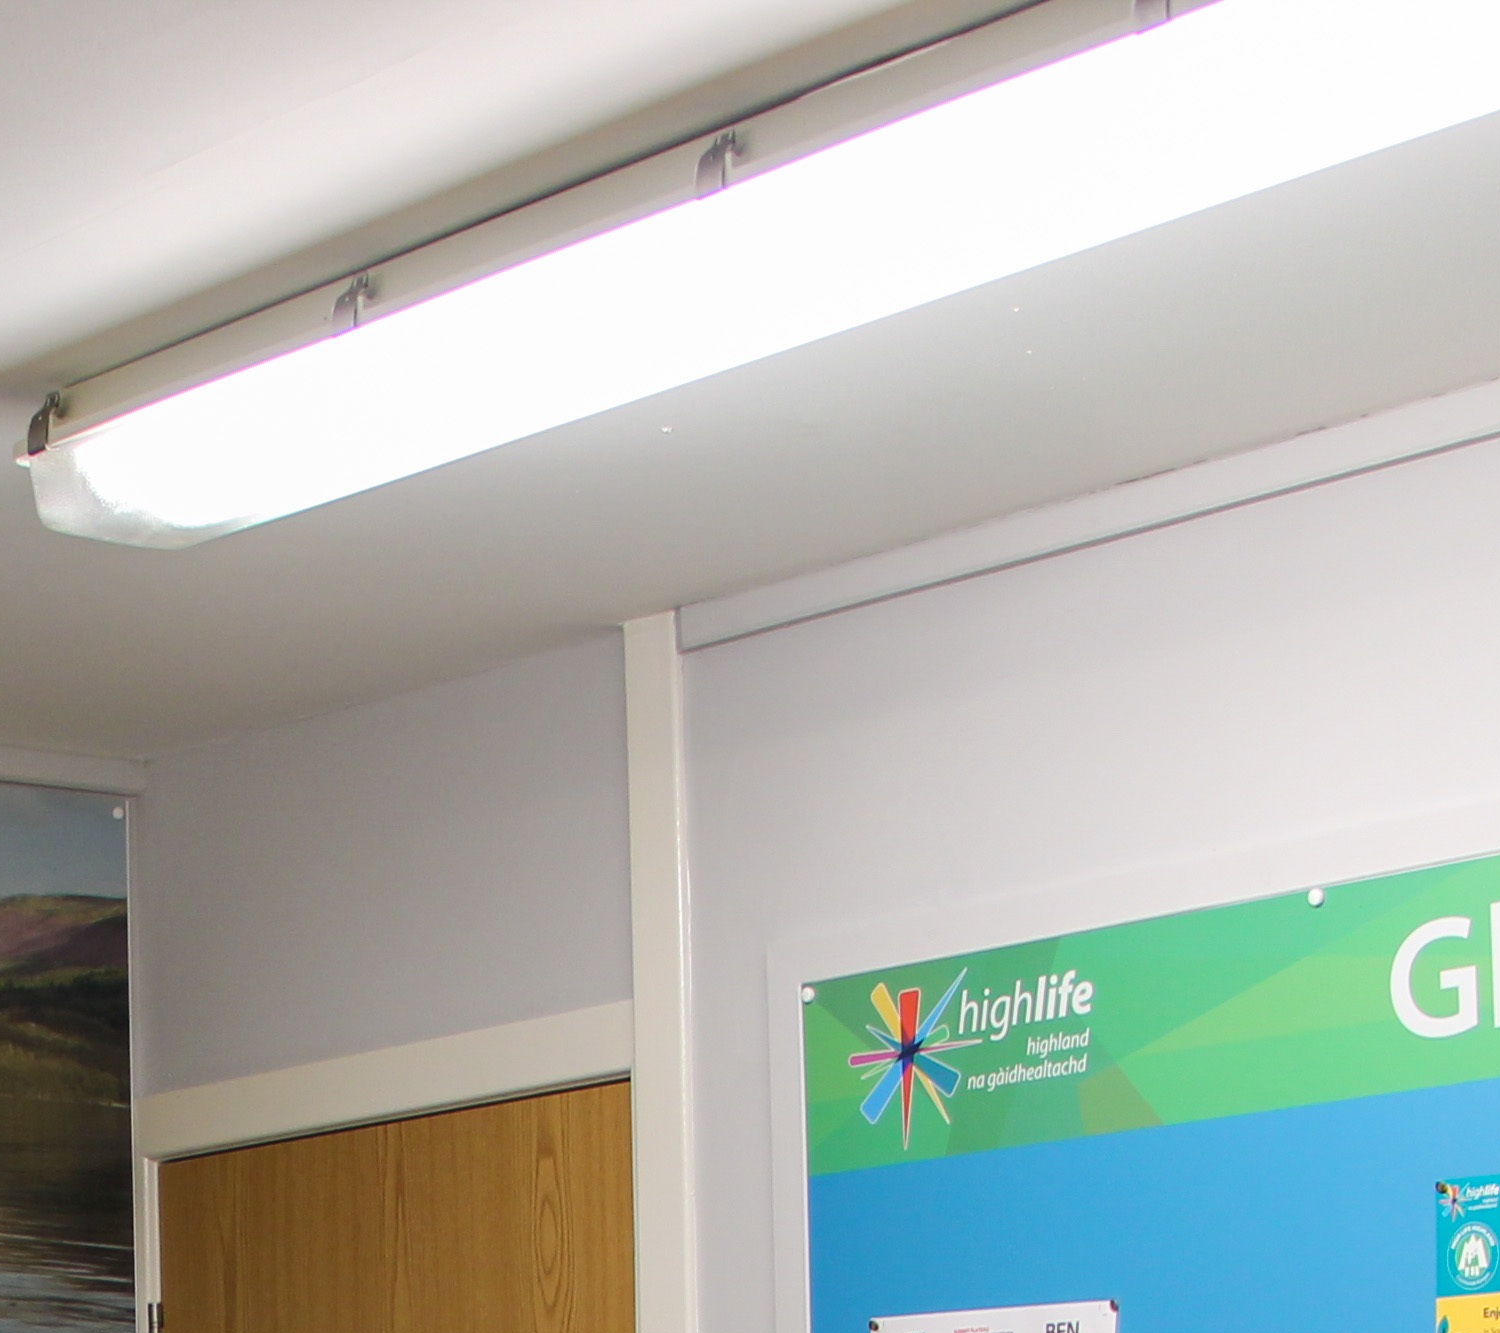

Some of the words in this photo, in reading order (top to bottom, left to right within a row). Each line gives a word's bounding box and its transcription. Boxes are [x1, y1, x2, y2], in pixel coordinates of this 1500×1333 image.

[958, 970, 1093, 1041] highlife
[1026, 1027, 1090, 1058] highland
[967, 1075, 984, 1090] na
[987, 1053, 1088, 1092] gàidhealtachd
